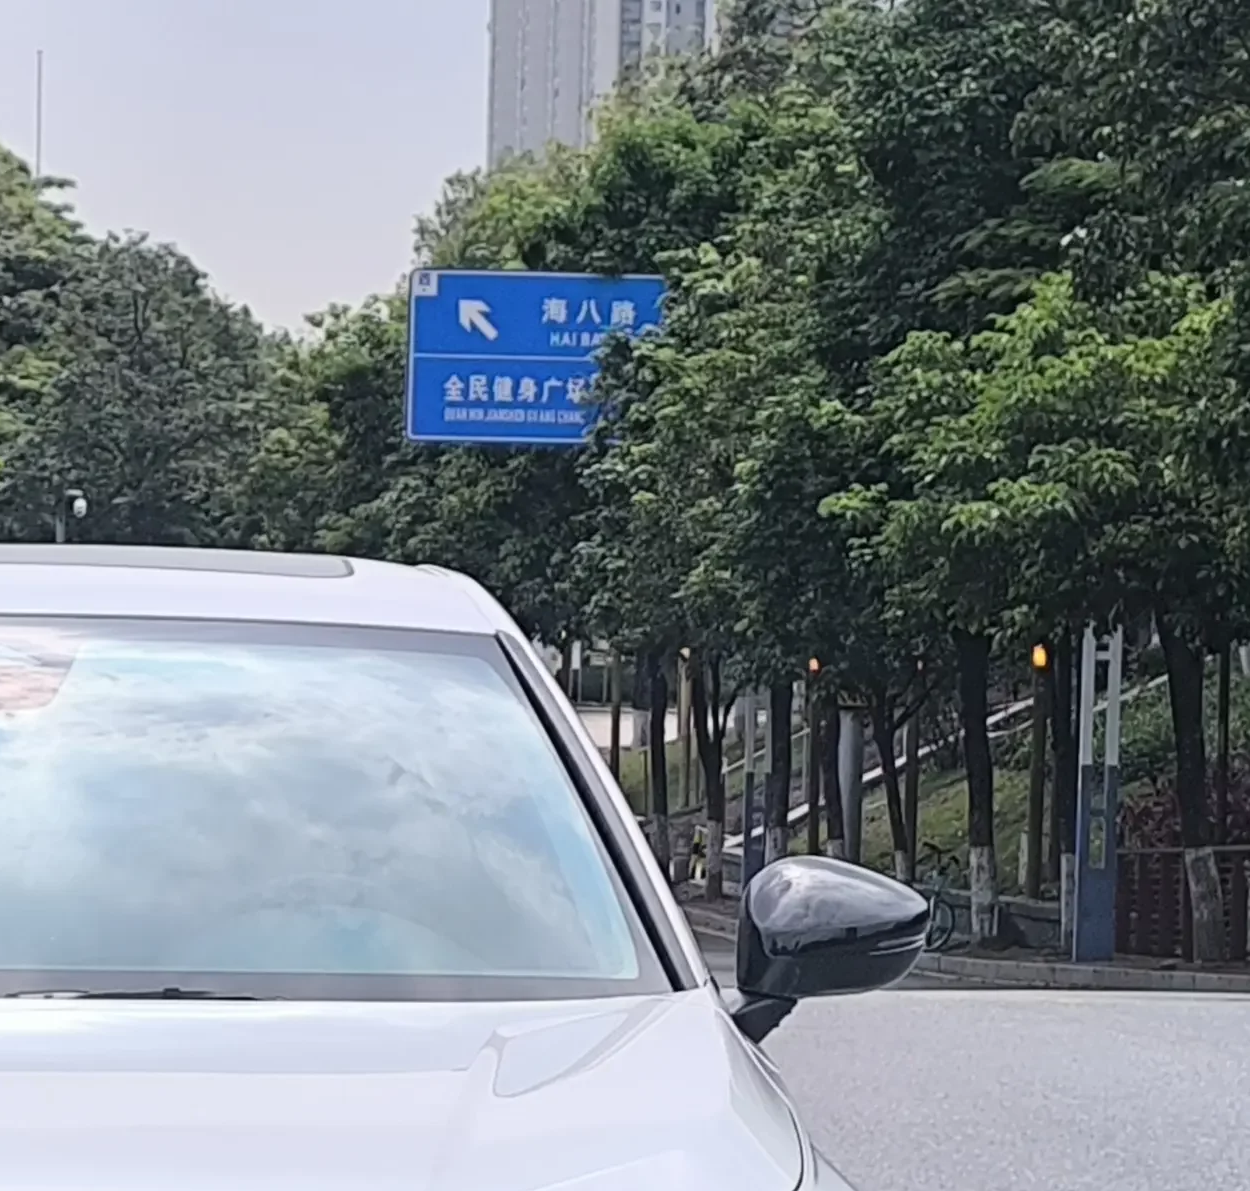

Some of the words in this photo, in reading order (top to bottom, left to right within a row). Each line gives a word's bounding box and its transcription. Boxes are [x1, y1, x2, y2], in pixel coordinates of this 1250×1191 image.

[542, 297, 636, 325] 海八路
[550, 331, 577, 347] HAI
